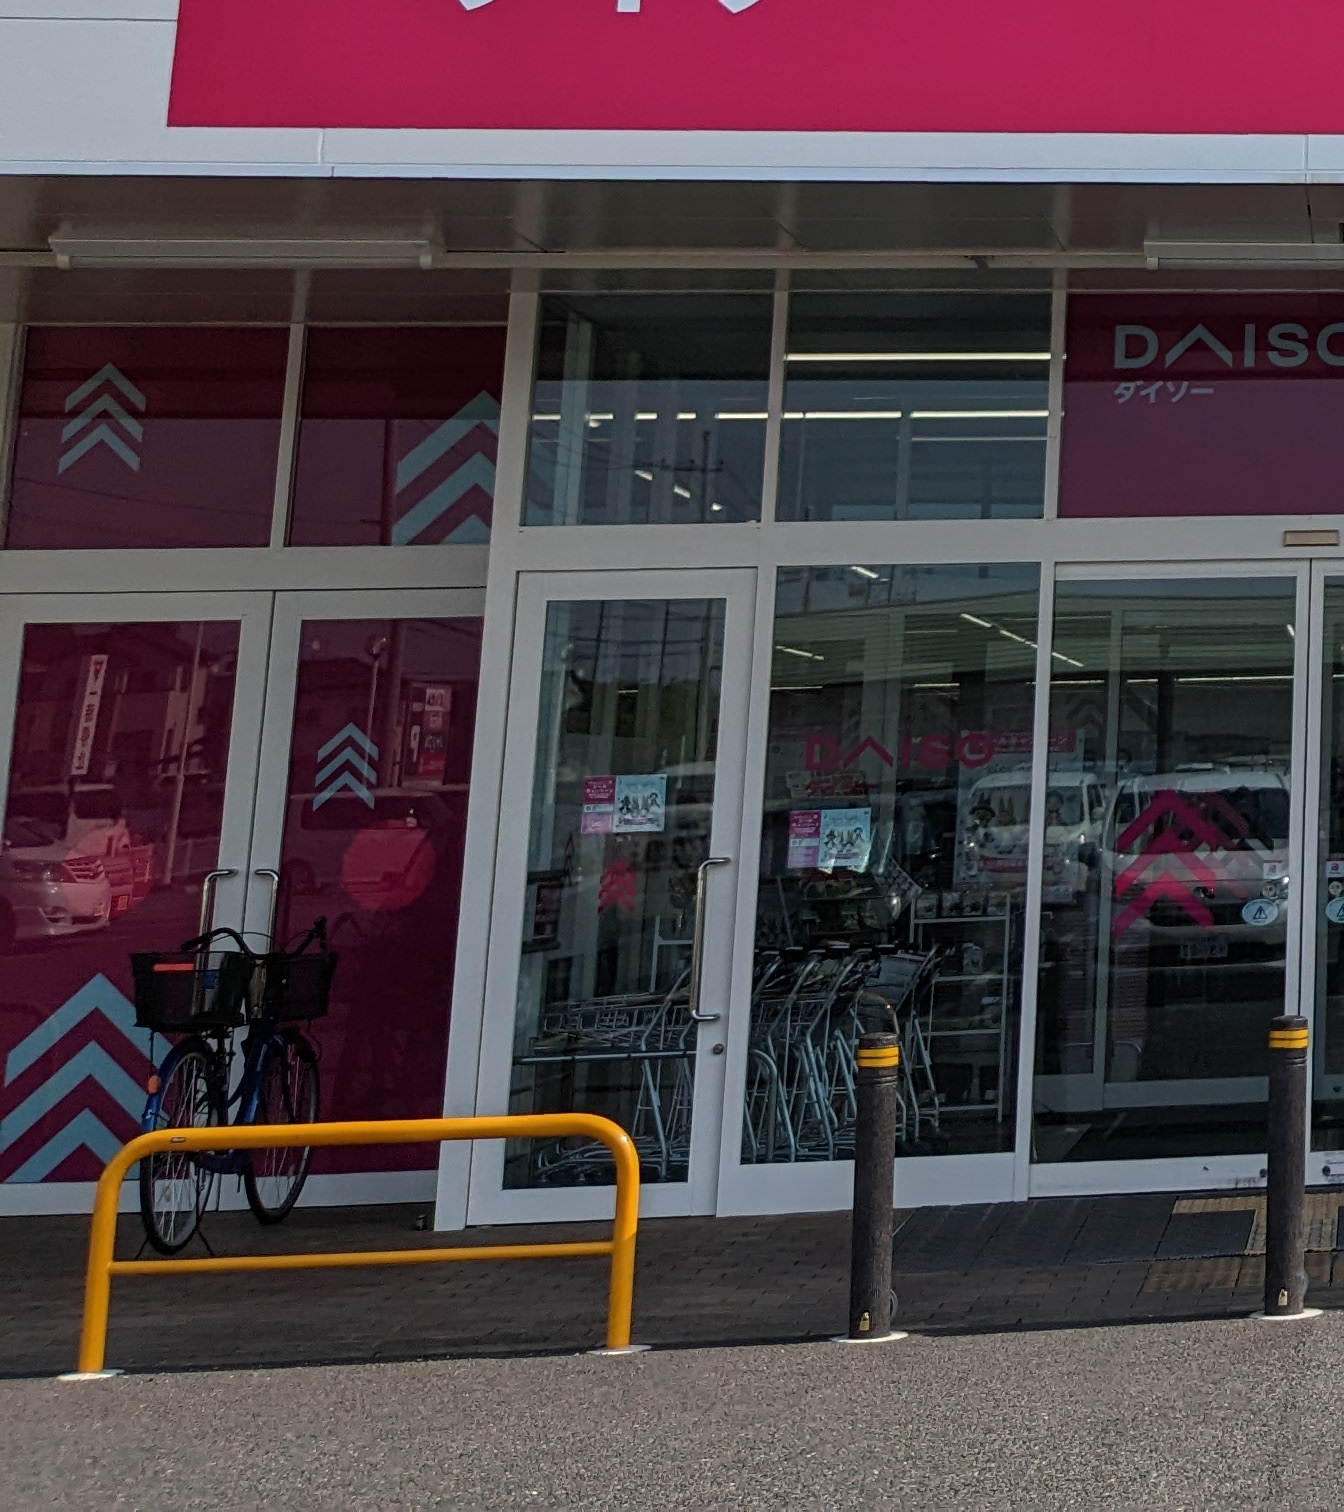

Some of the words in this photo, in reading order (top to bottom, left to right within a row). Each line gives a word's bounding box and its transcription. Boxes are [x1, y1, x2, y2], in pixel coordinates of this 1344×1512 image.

[1113, 379, 1215, 405] ダイソー
[804, 731, 995, 772] DAISO
